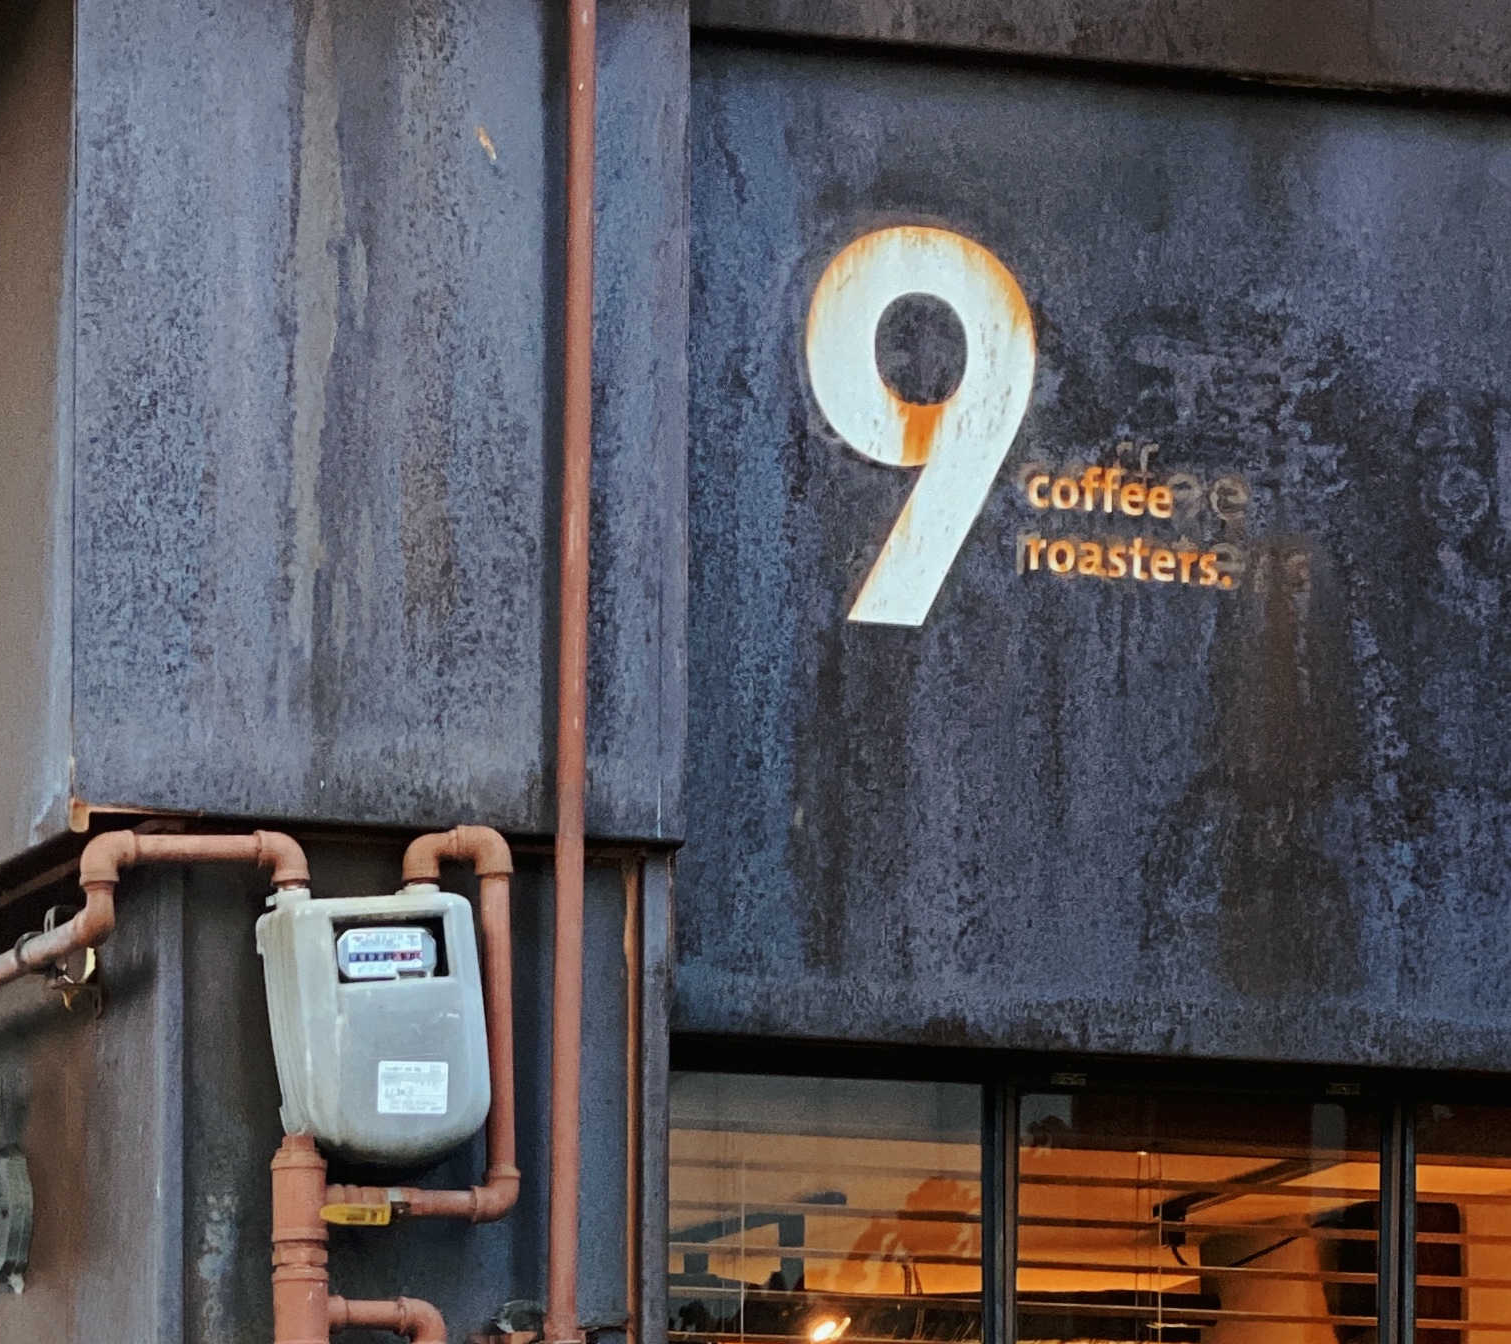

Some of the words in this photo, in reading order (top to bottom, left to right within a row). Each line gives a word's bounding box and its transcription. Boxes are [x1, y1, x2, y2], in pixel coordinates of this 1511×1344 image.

[807, 226, 1036, 626] 9
[1028, 466, 1174, 518] coffee
[1027, 537, 1232, 587] roasters.
